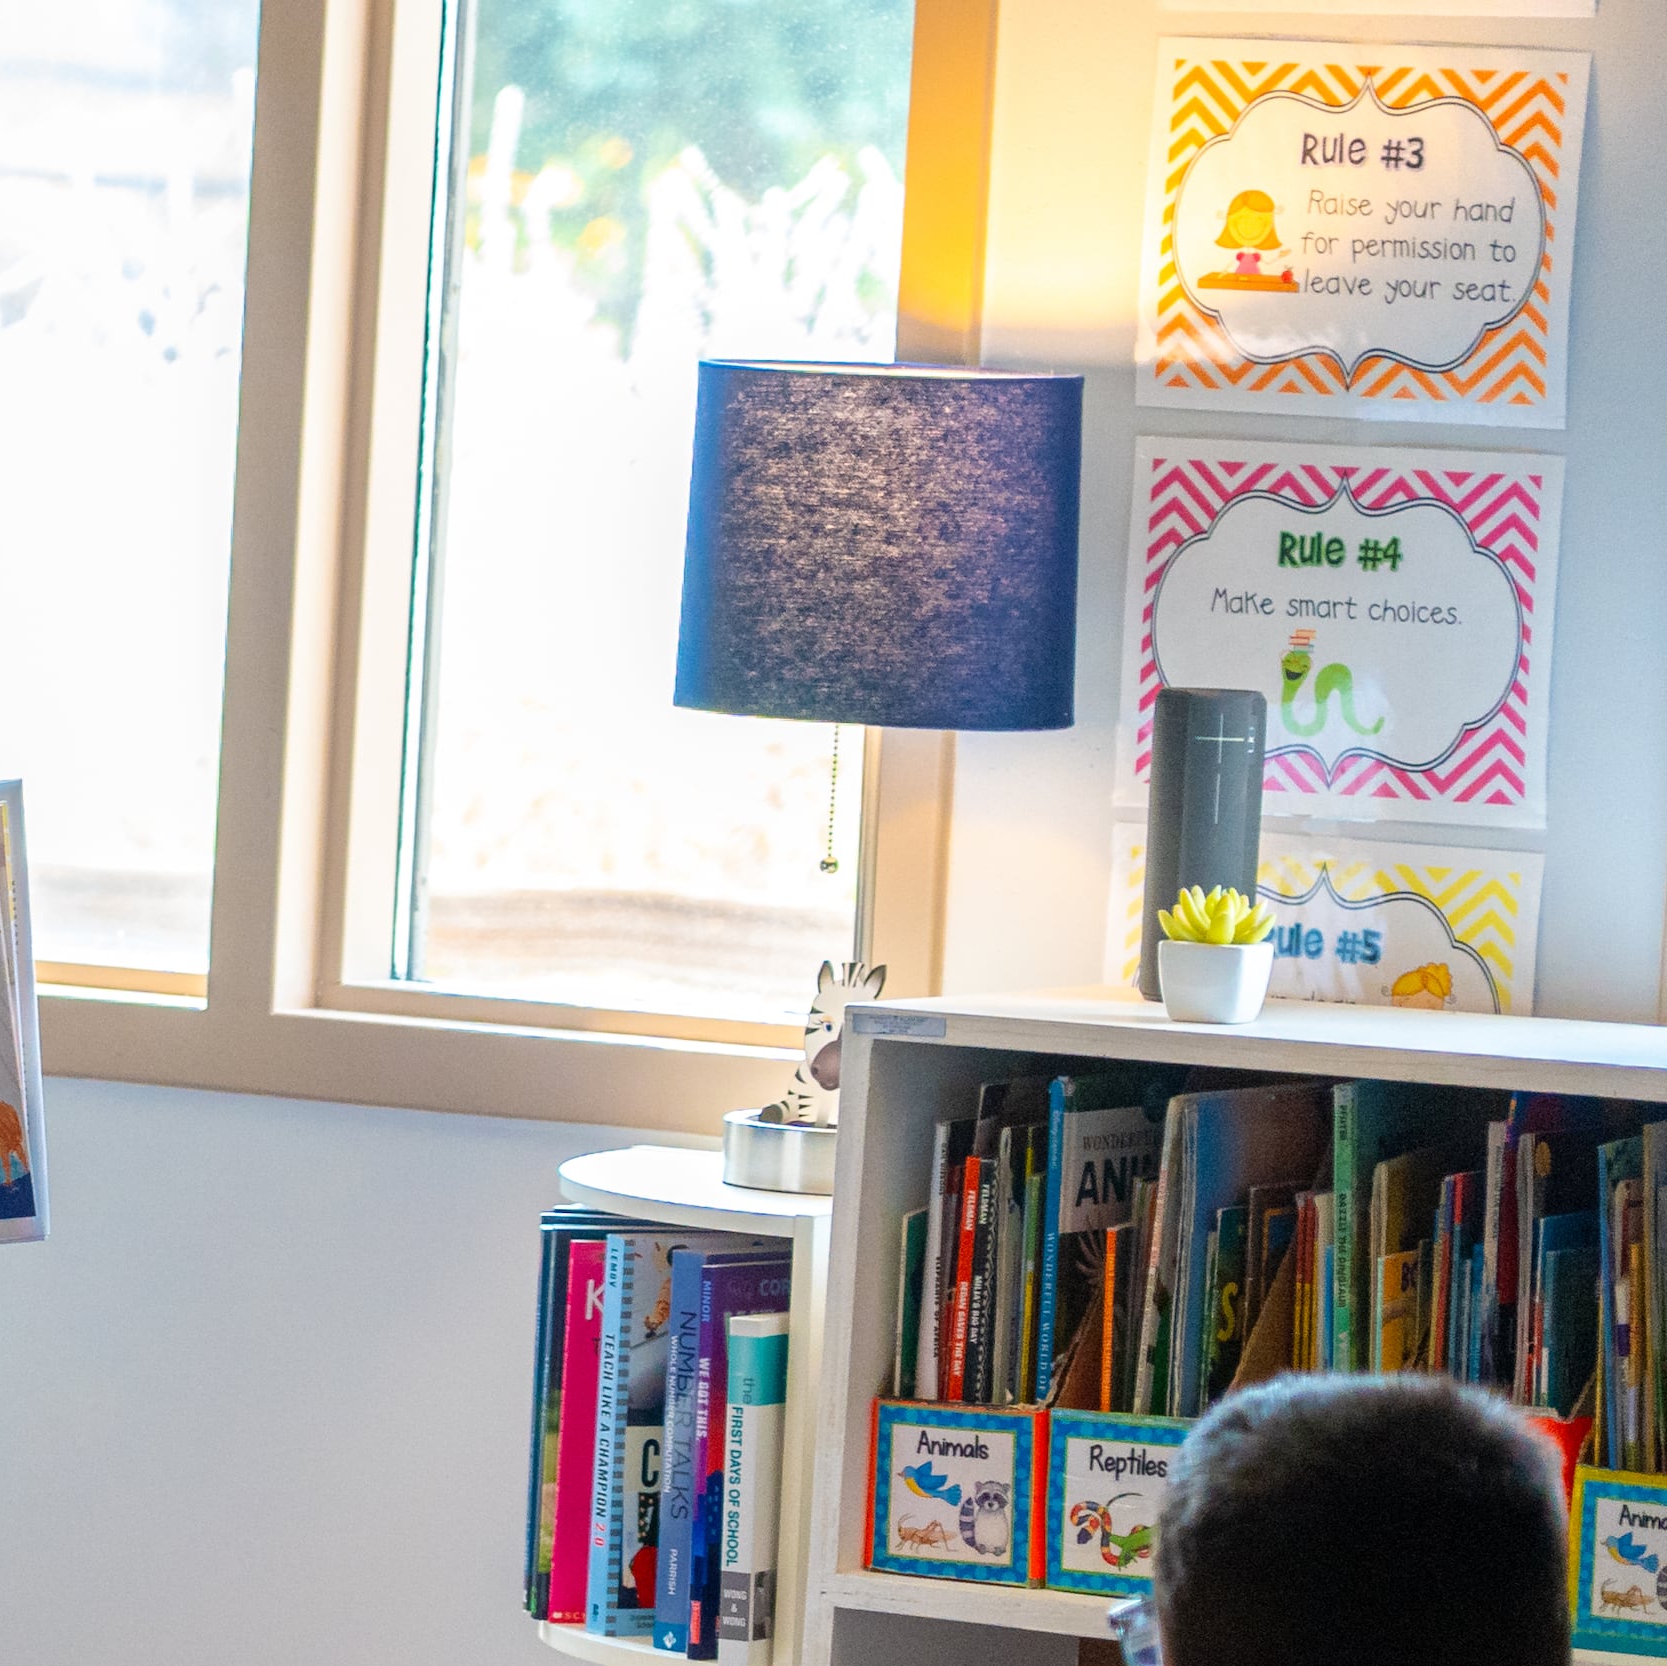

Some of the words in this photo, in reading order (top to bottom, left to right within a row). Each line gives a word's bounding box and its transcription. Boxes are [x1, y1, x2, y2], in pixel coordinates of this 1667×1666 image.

[1301, 132, 1366, 166] Rule
[1381, 137, 1425, 169] #3
[1307, 189, 1373, 217] Raise
[1384, 198, 1441, 225] your
[1452, 197, 1516, 223] hand
[1301, 231, 1339, 256] for
[1352, 236, 1475, 263] permission
[1490, 241, 1516, 263] to
[1304, 269, 1372, 297] leave
[1384, 278, 1441, 304] your
[1453, 279, 1517, 304] seat.
[1278, 531, 1346, 567] Rule
[1358, 536, 1402, 571] #4
[1211, 587, 1275, 617] Make
[1286, 595, 1358, 621] smart
[1368, 600, 1463, 625] choices.
[1336, 927, 1382, 964] #5
[609, 1248, 619, 1288] LEMOV
[701, 1280, 712, 1322] MINOR
[669, 1335, 679, 1371] WHOLE
[969, 1327, 979, 1344] DAY
[1038, 1323, 1050, 1370] WORLD
[601, 1334, 615, 1380] TEACH
[675, 1311, 697, 1428] NUMBER
[699, 1357, 710, 1376] WE
[952, 1360, 962, 1376] DAY
[600, 1384, 611, 1420] LIKE
[697, 1381, 709, 1407] GOT
[742, 1377, 755, 1405] the
[601, 1422, 610, 1432] A
[730, 1406, 744, 1446] FIRST
[663, 1422, 675, 1493] COMPUTATION
[916, 1429, 989, 1462] Animals
[1089, 1444, 1168, 1481] Reptiles
[595, 1437, 610, 1518] CHAMPION
[671, 1438, 692, 1520] TALKS
[728, 1450, 742, 1488] DAYS
[728, 1489, 740, 1507] OF
[726, 1510, 740, 1567] SCHOOL
[668, 1549, 678, 1595] PARRISH
[723, 1588, 748, 1601] WONG
[730, 1603, 738, 1613] &
[722, 1615, 746, 1628] WONG
